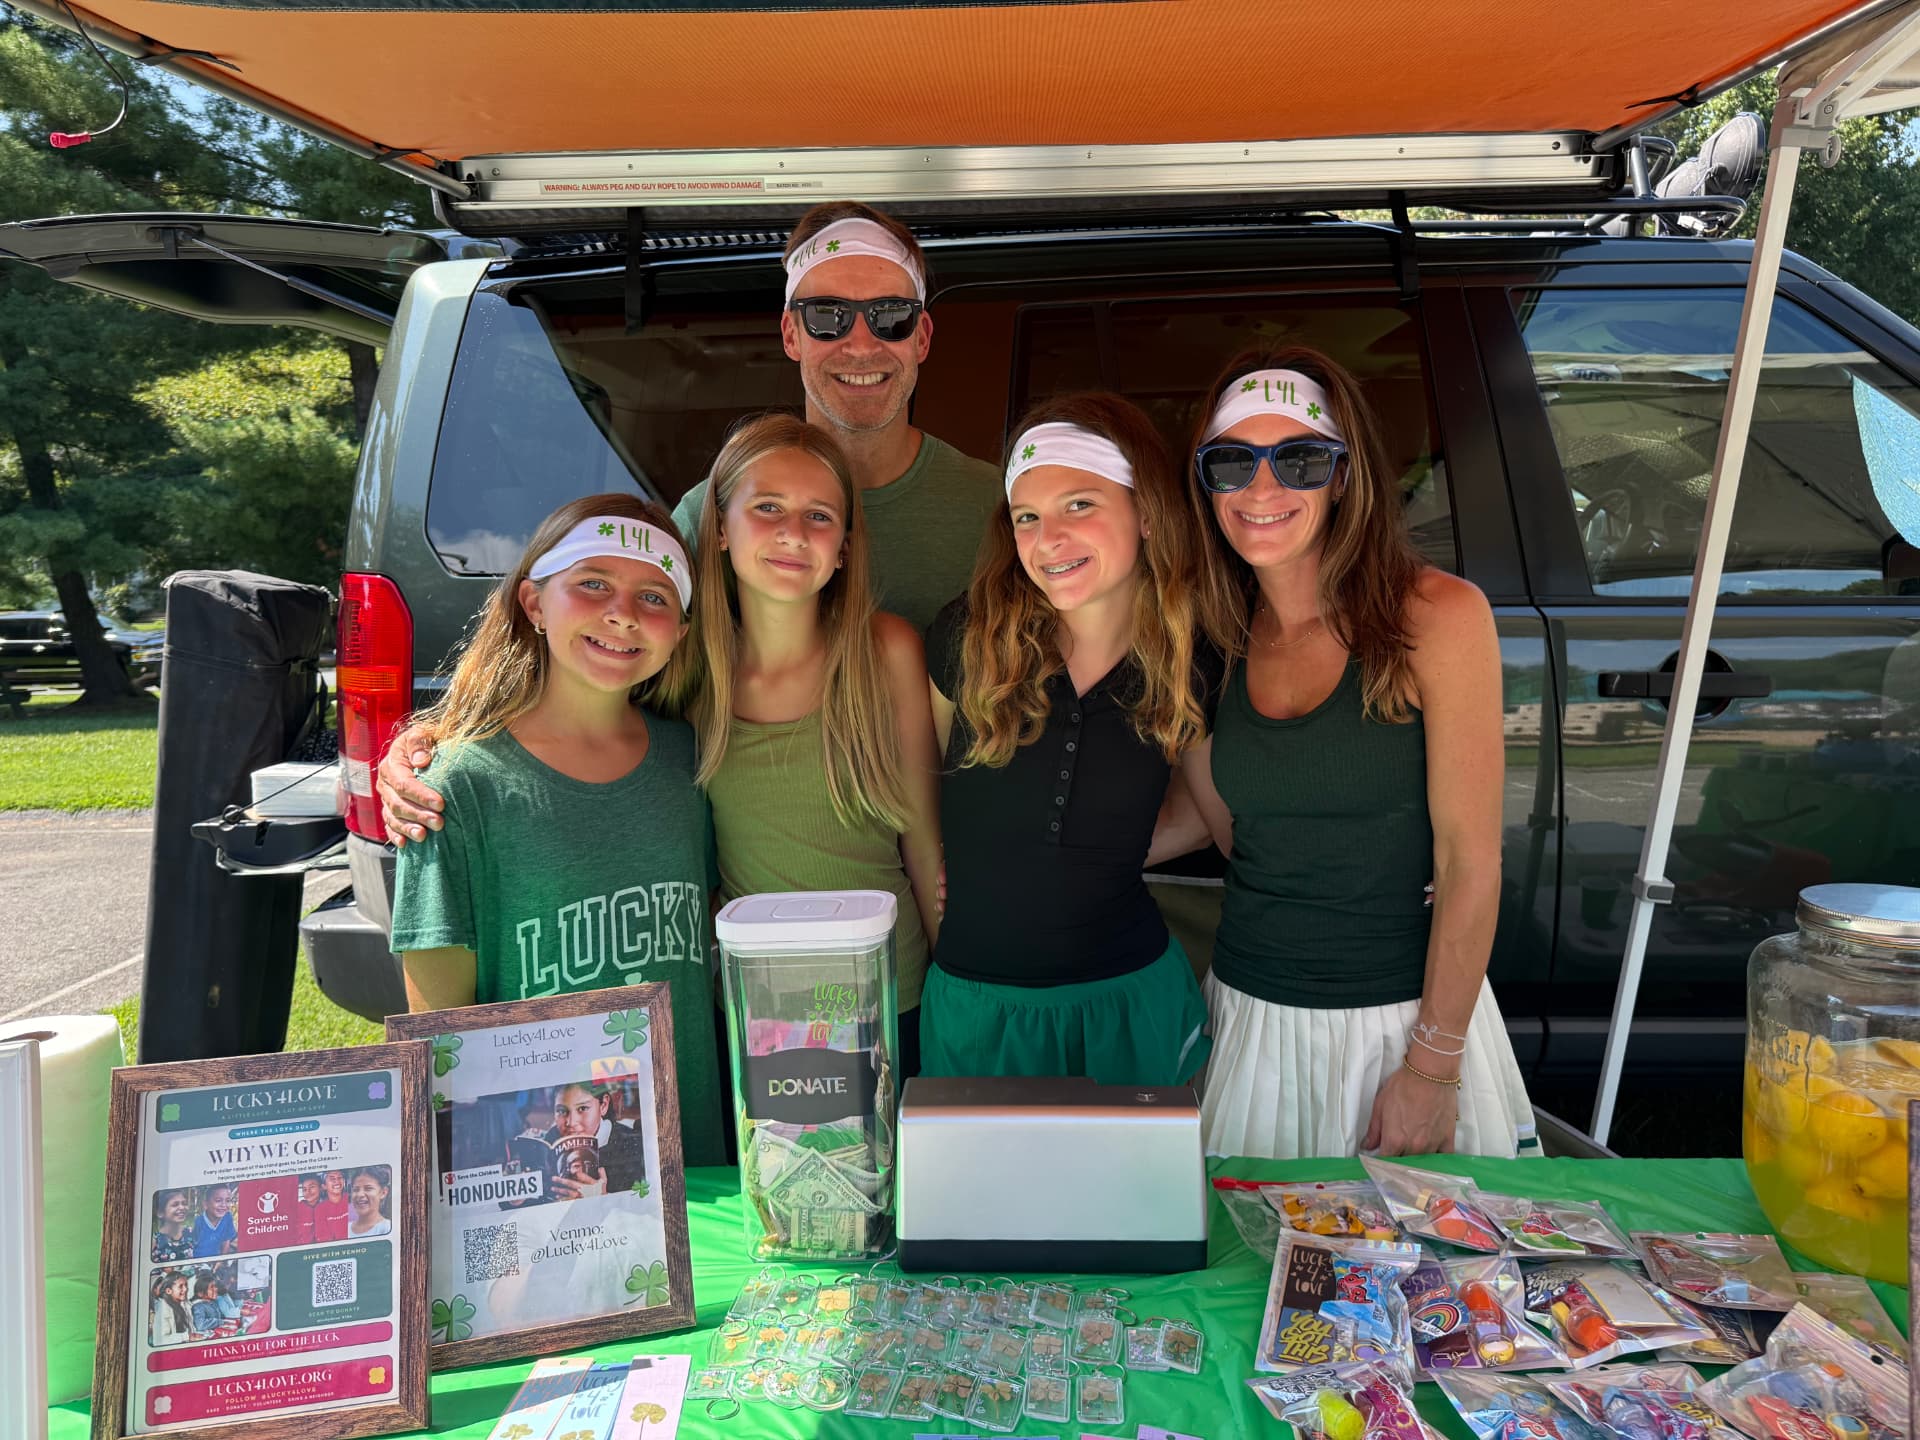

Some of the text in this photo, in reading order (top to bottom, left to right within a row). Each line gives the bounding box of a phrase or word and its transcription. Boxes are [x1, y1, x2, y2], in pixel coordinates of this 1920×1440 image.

[544, 183, 580, 191] WARNING:
[582, 183, 609, 191] ALWAYS
[688, 182, 710, 190] AVOID
[730, 181, 762, 189] DAMAGE
[516, 881, 704, 1000] LUCKY
[493, 1026, 576, 1048] Lucky4Love
[500, 1048, 573, 1069] Fundraiser
[768, 1076, 848, 1097] DONATE
[212, 1084, 338, 1112] LUCKY4LOVE
[208, 1136, 340, 1164] WHY WE GIVE
[555, 1138, 595, 1156] HAMLET
[448, 1176, 538, 1207] HONDURAS
[246, 1224, 289, 1235] Children
[247, 1213, 289, 1225] Save the
[549, 1225, 604, 1242] Venmo:
[530, 1235, 630, 1264] @Lucky4Love
[1289, 1311, 1334, 1334] YOU
[202, 1345, 239, 1359] THANK
[240, 1342, 264, 1354] YOU
[265, 1338, 287, 1351] FOR
[288, 1335, 311, 1347] THE
[311, 1332, 340, 1344] LUCK
[1279, 1327, 1333, 1346] GOT
[1278, 1340, 1332, 1365] THIS
[208, 1368, 333, 1398] LUCKY4LOVE.ORG
[225, 1394, 257, 1404] FOLLOW
[570, 1402, 607, 1420] LOVE
